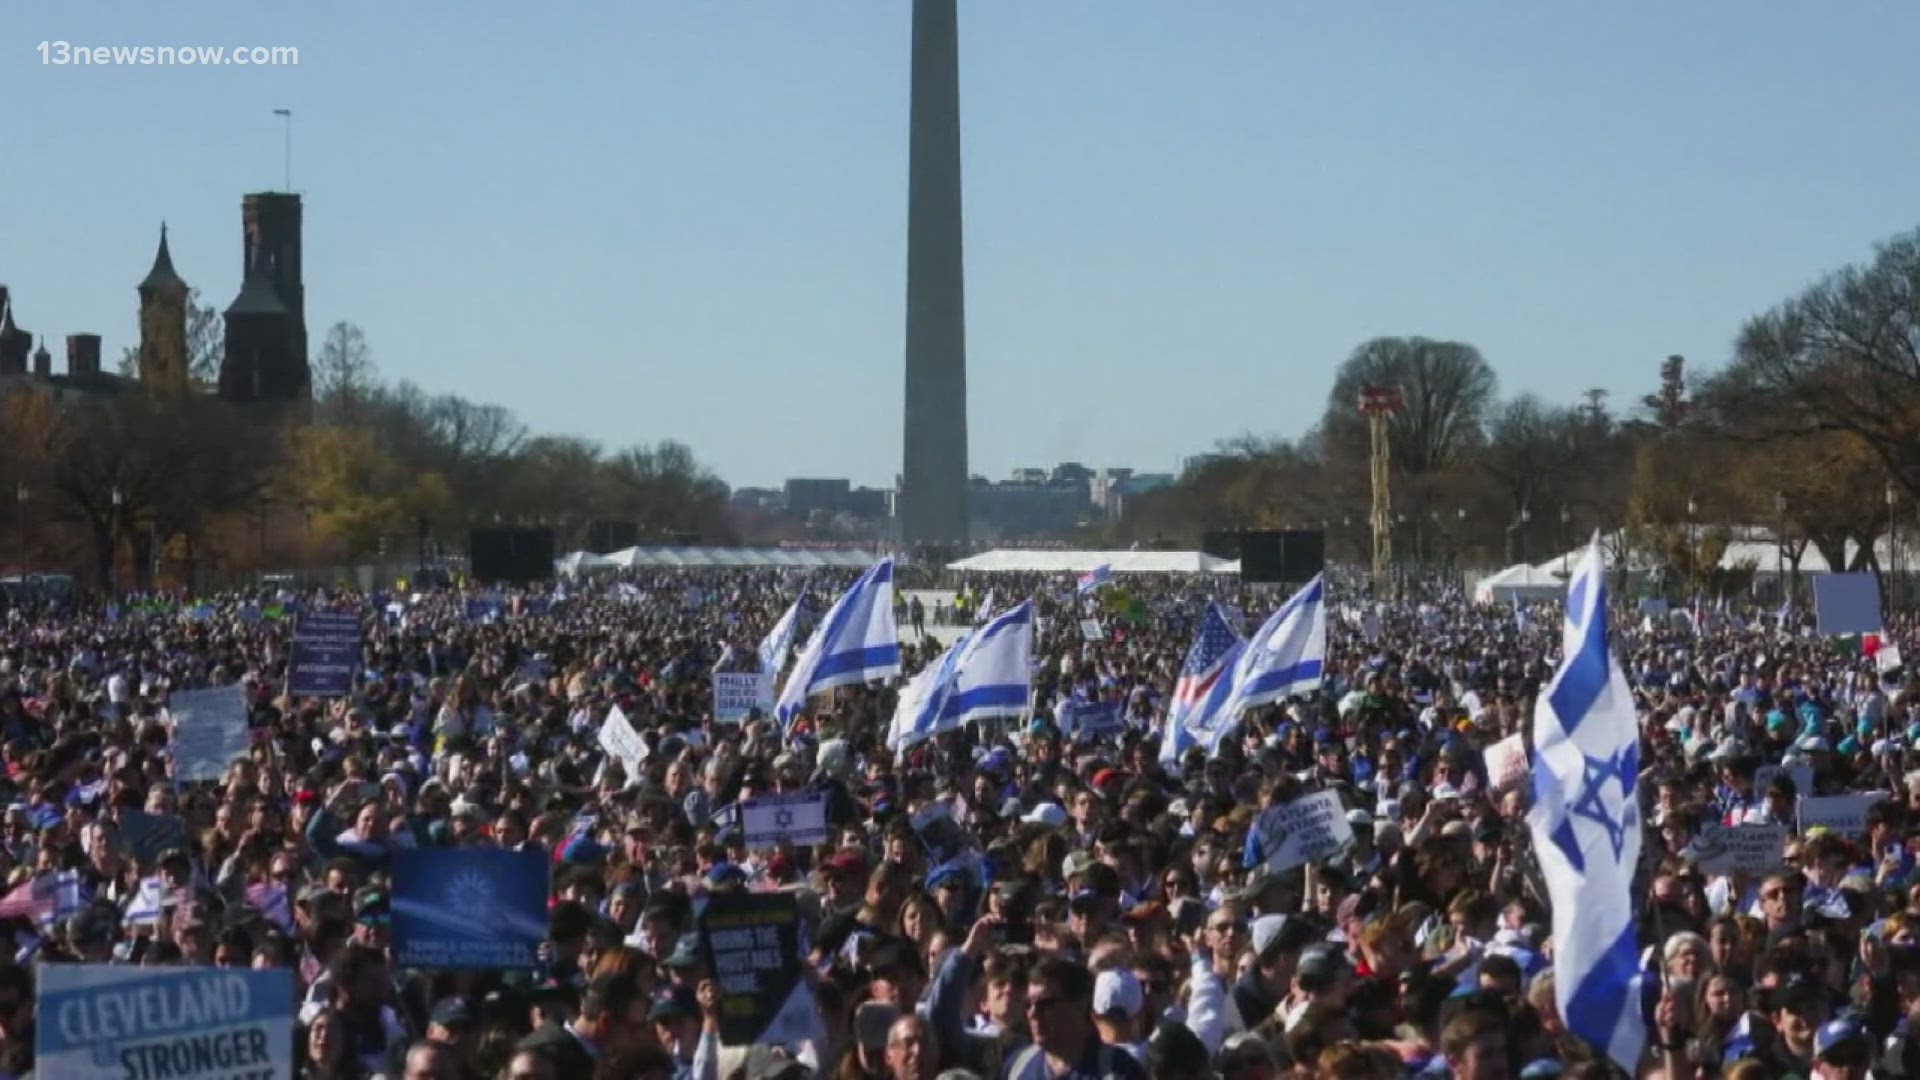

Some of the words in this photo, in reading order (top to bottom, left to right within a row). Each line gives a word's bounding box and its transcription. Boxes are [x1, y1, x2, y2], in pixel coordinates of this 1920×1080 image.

[717, 676, 759, 687] PHILLY
[58, 974, 251, 1045] CLEVELAND
[120, 1025, 270, 1080] STRONGER
